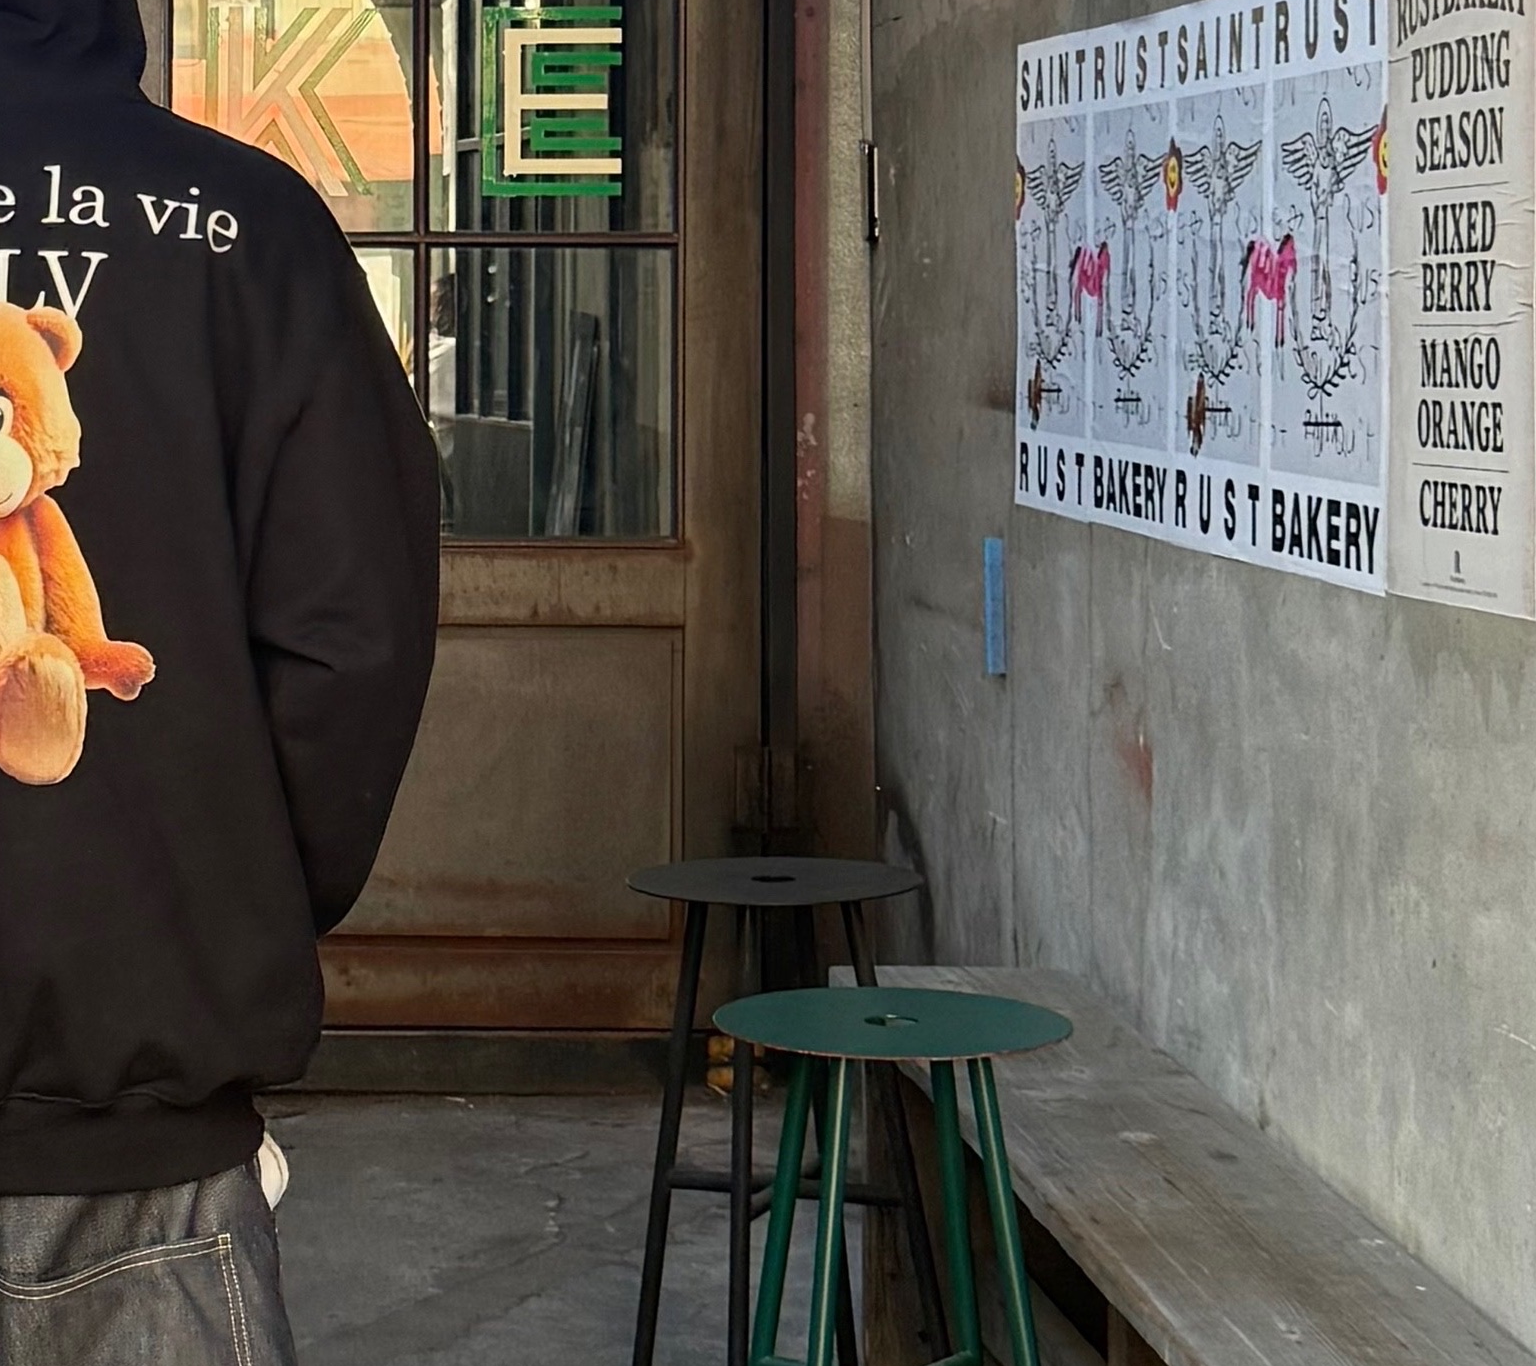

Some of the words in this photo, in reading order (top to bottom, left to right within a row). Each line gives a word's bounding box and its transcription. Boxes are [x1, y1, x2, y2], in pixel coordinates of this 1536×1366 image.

[1411, 29, 1510, 103] PUDDING
[1415, 106, 1504, 174] SEASON
[41, 164, 110, 229] la
[136, 186, 240, 254] vie
[1421, 200, 1497, 257] MIXED
[1421, 260, 1496, 312] BERRY
[1420, 337, 1501, 390] MANGO
[1417, 399, 1504, 453] ORANGE
[1019, 441, 1085, 506] RUST
[1093, 455, 1168, 524] BAKERY
[1175, 469, 1260, 547] RUST
[1272, 488, 1380, 575] BAKERY
[1419, 479, 1502, 536] CHERRY
